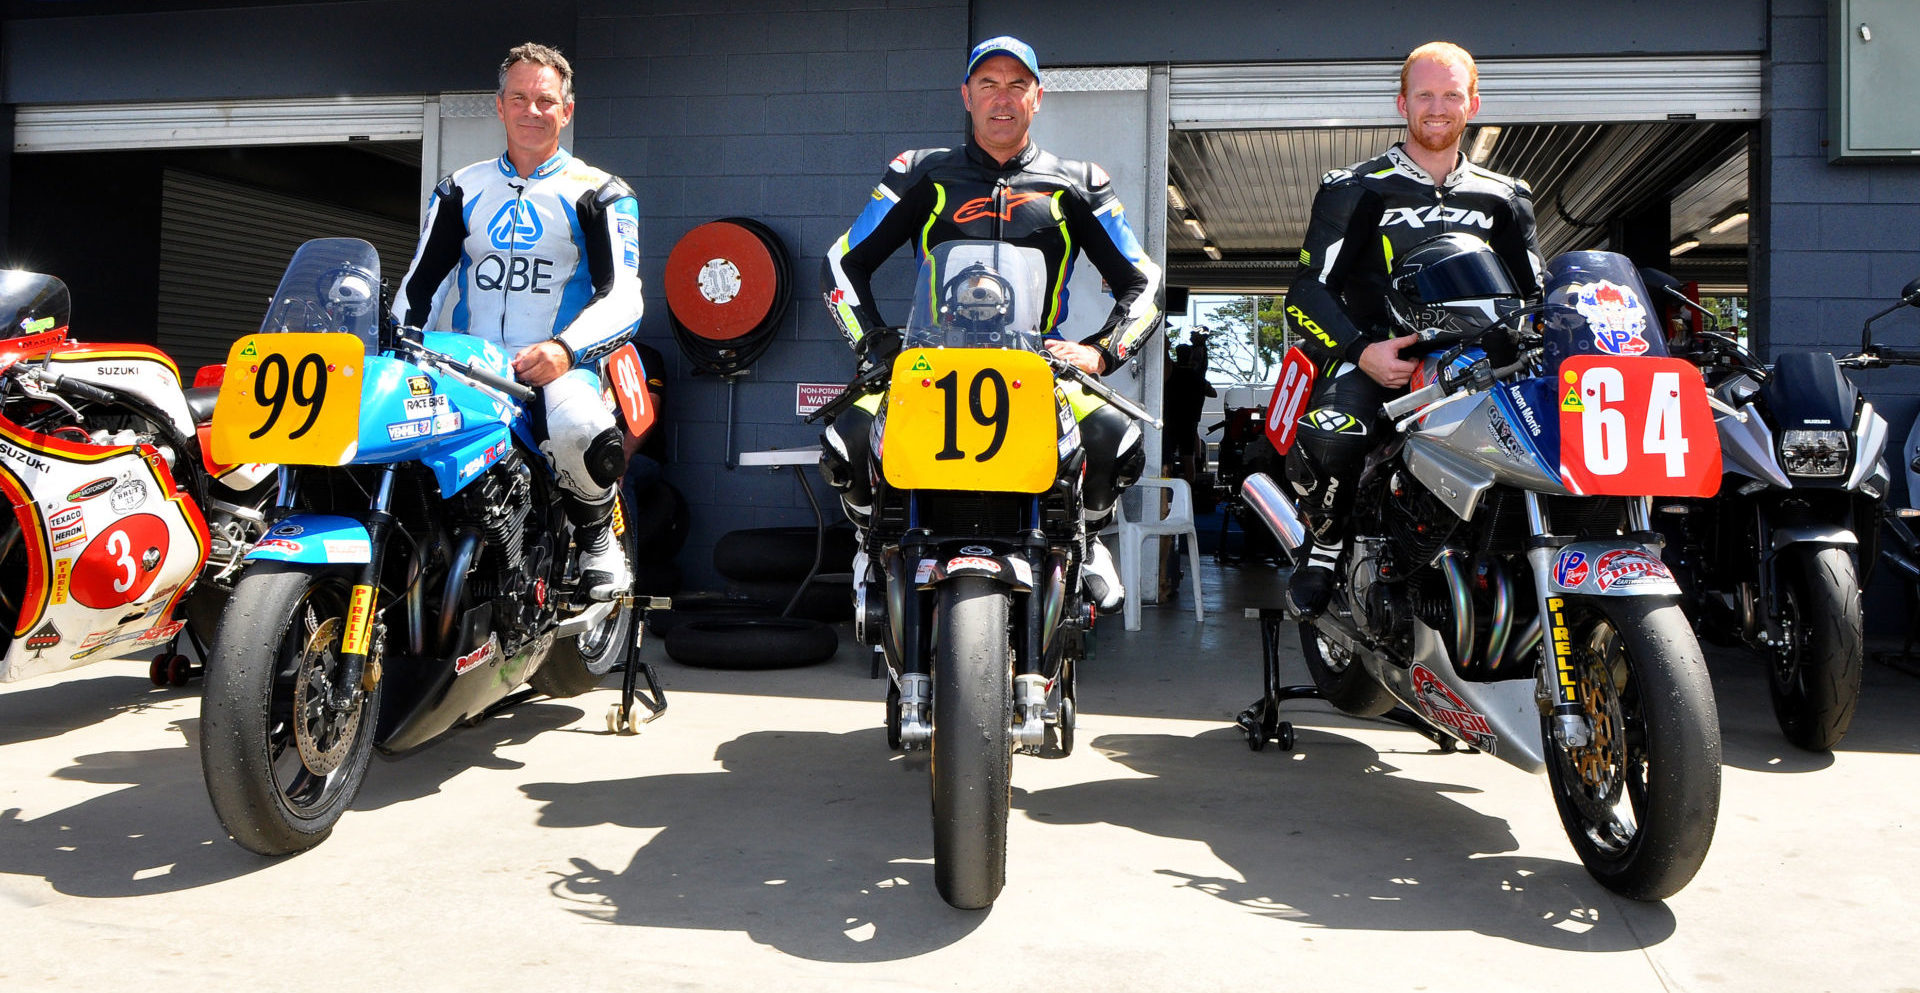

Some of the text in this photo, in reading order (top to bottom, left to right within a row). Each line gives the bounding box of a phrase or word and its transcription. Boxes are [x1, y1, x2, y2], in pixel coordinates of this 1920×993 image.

[475, 254, 553, 294] QBE
[97, 366, 139, 376] SUZUKI
[617, 354, 645, 422] 99
[249, 353, 327, 440] 99
[807, 396, 837, 404] WATE
[935, 368, 1010, 463] 19
[1270, 361, 1309, 445] 64
[1510, 385, 1541, 437] Aaron Morris
[1581, 367, 1689, 478] 64
[0, 443, 51, 474] SUZUKI
[117, 487, 139, 500] BRUT
[51, 510, 82, 527] TEXACO
[55, 526, 82, 541] HERON
[55, 561, 68, 603] PIRELLI
[106, 530, 136, 593] 3
[1558, 552, 1586, 587] VP
[349, 588, 366, 650] PIRELLI
[1548, 598, 1576, 700] PIRELLI
